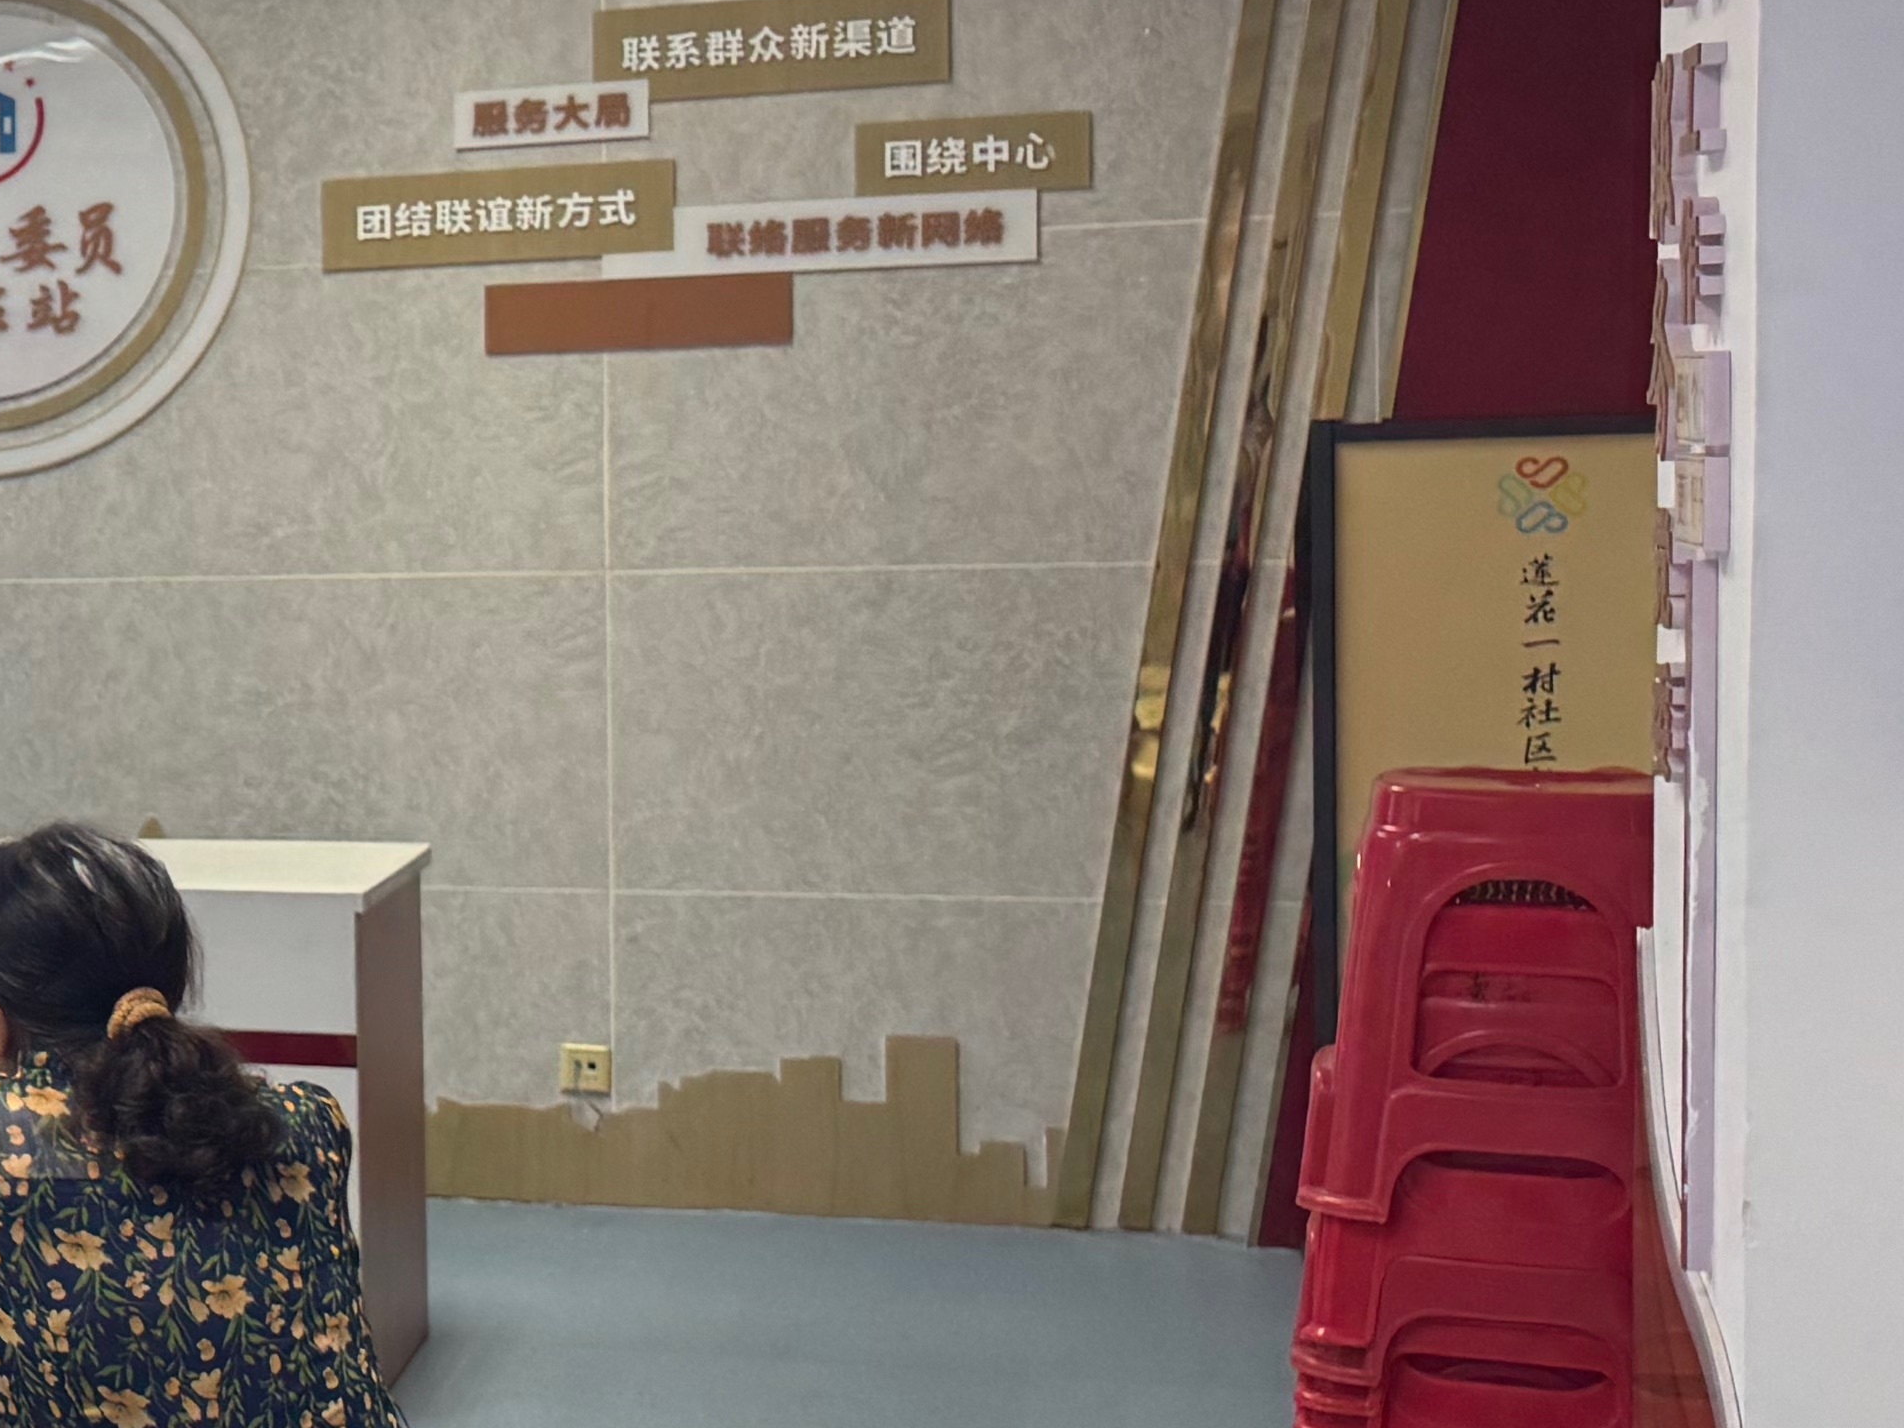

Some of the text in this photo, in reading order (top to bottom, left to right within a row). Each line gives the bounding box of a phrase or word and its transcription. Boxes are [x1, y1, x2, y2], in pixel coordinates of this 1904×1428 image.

[621, 16, 918, 74] 联系群众新渠道
[472, 91, 632, 140] 服务大局
[883, 131, 1057, 179] 围绕中心
[355, 189, 638, 242] 团结联谊新方式
[706, 207, 1007, 259] 联络服务新网络
[1517, 554, 1562, 772] 莲花一村社区
